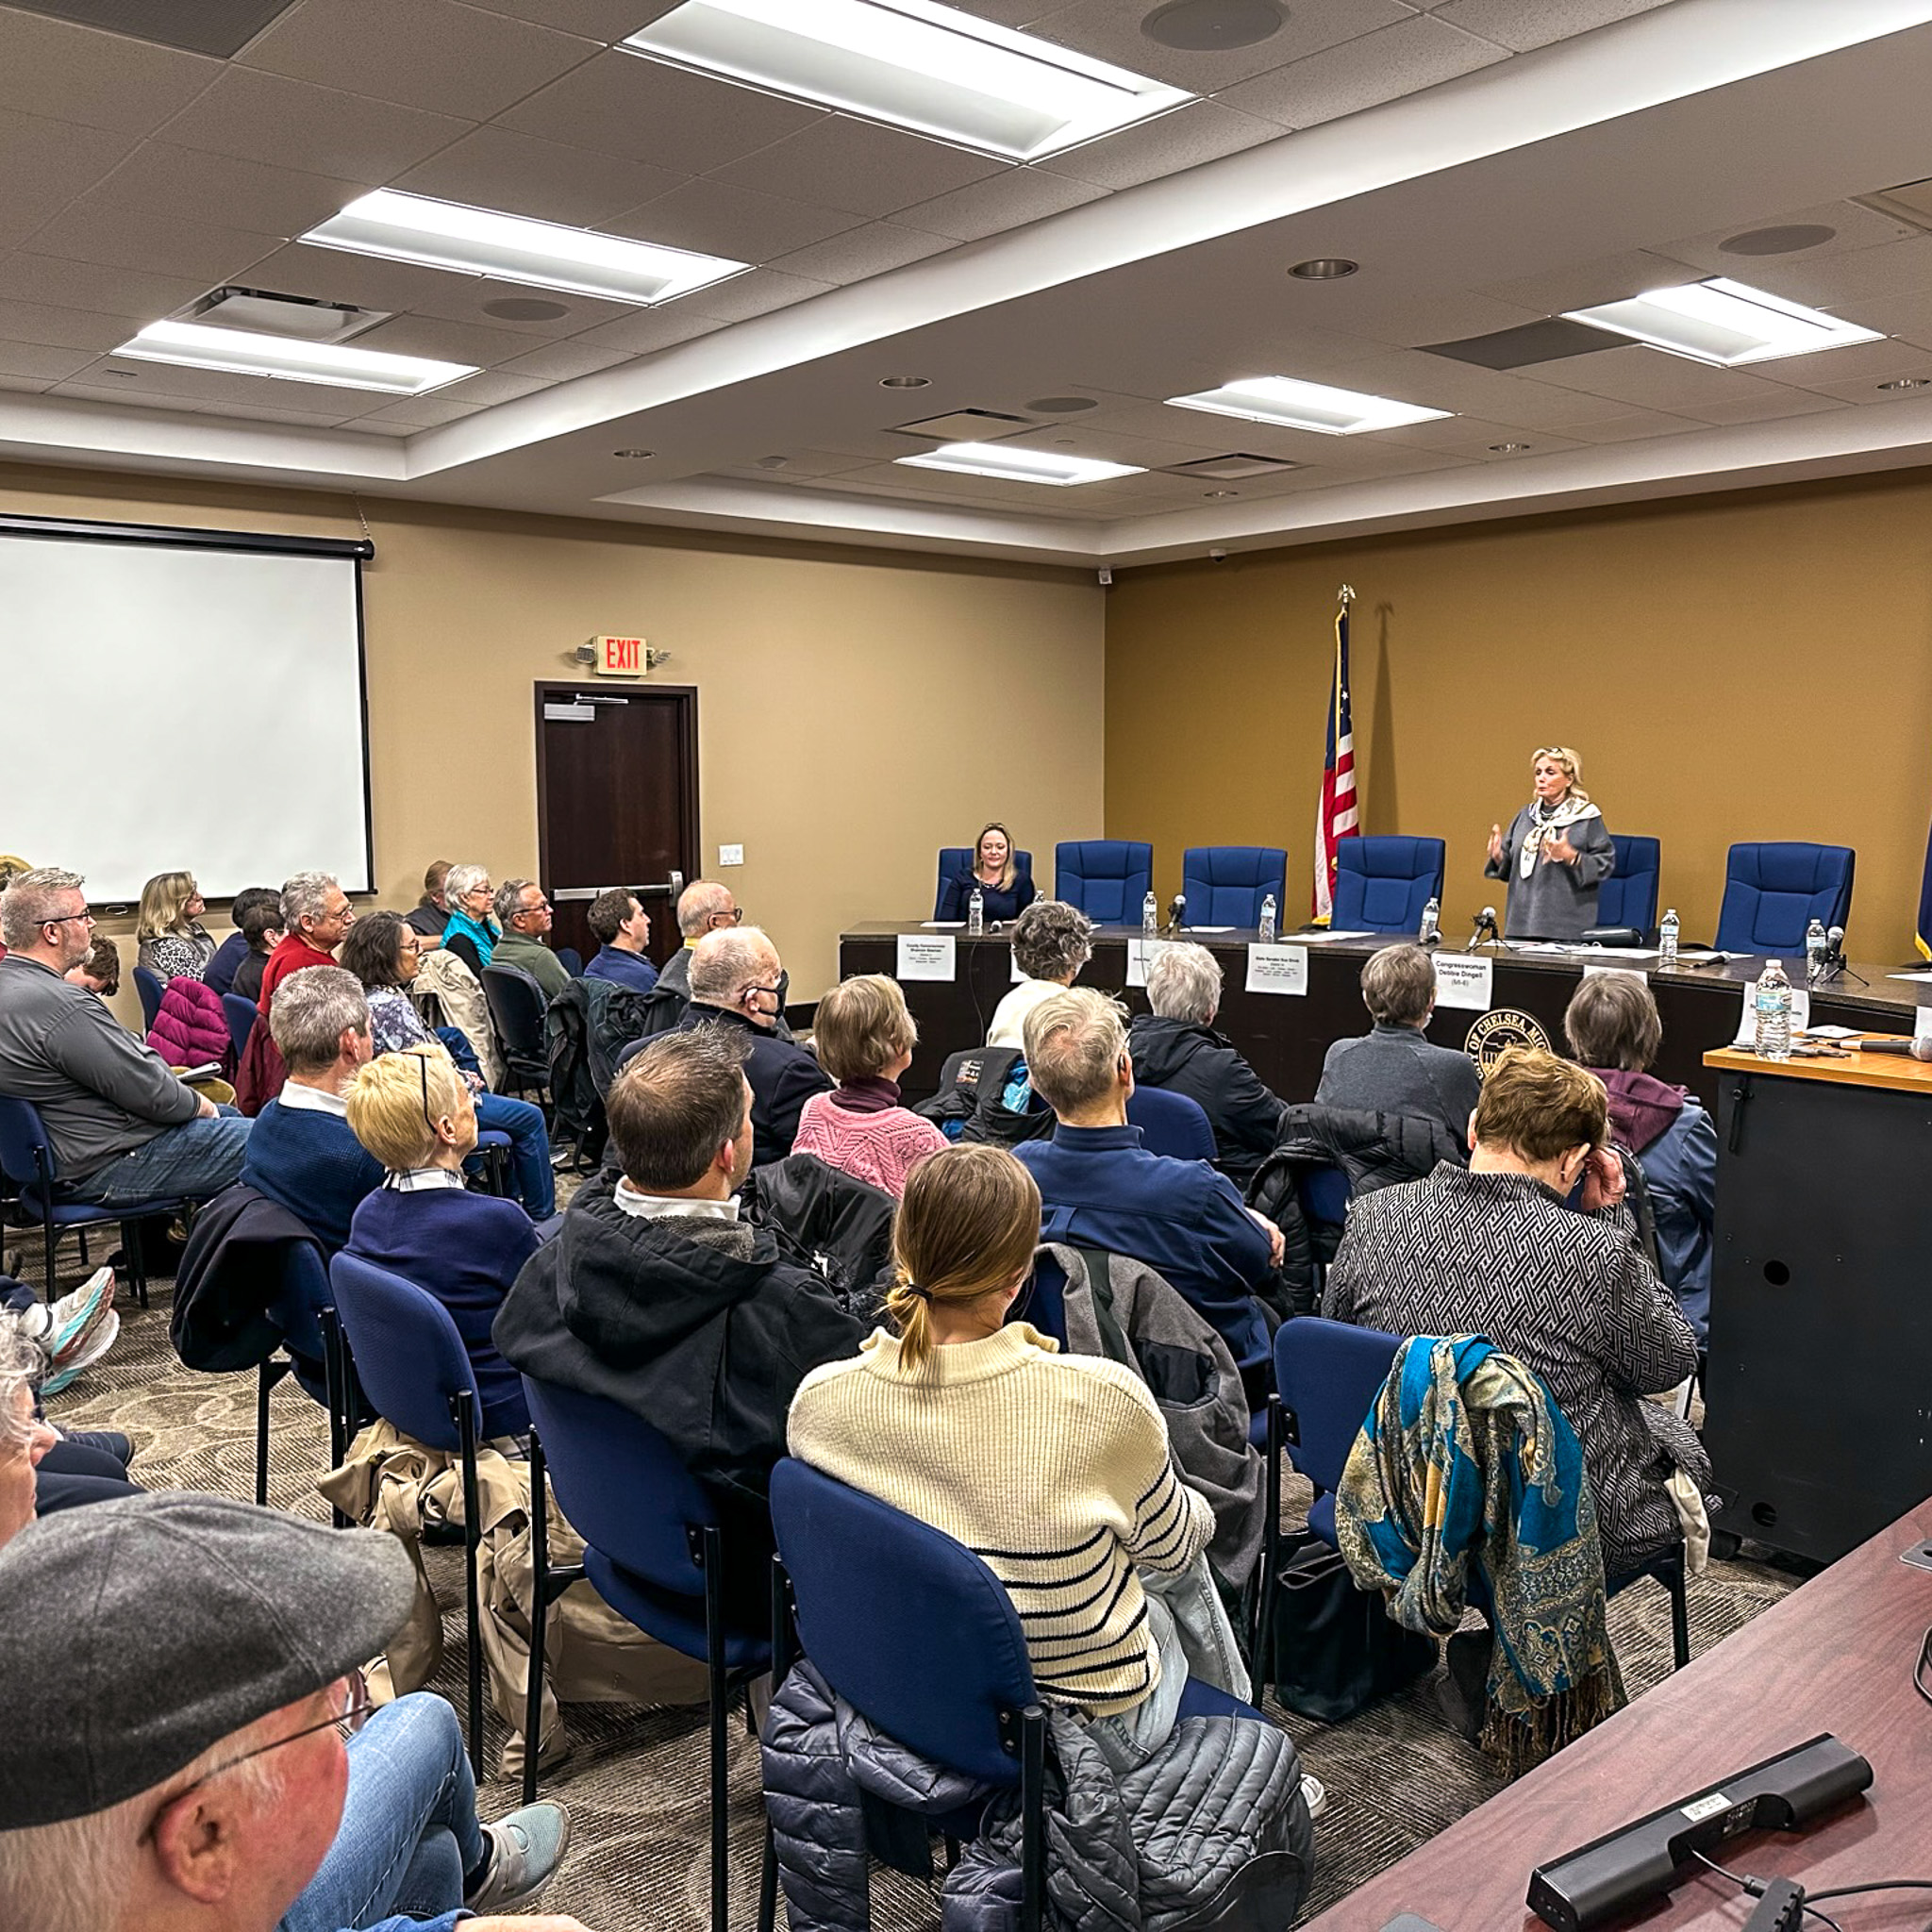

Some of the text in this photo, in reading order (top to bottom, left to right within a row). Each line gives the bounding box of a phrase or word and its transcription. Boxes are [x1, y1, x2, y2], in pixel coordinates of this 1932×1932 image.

[607, 639, 641, 669] EXIT
[1436, 960, 1487, 971] Congresswoman
[1469, 1032, 1482, 1051] OF
[1477, 1013, 1526, 1036] CHELSEA,
